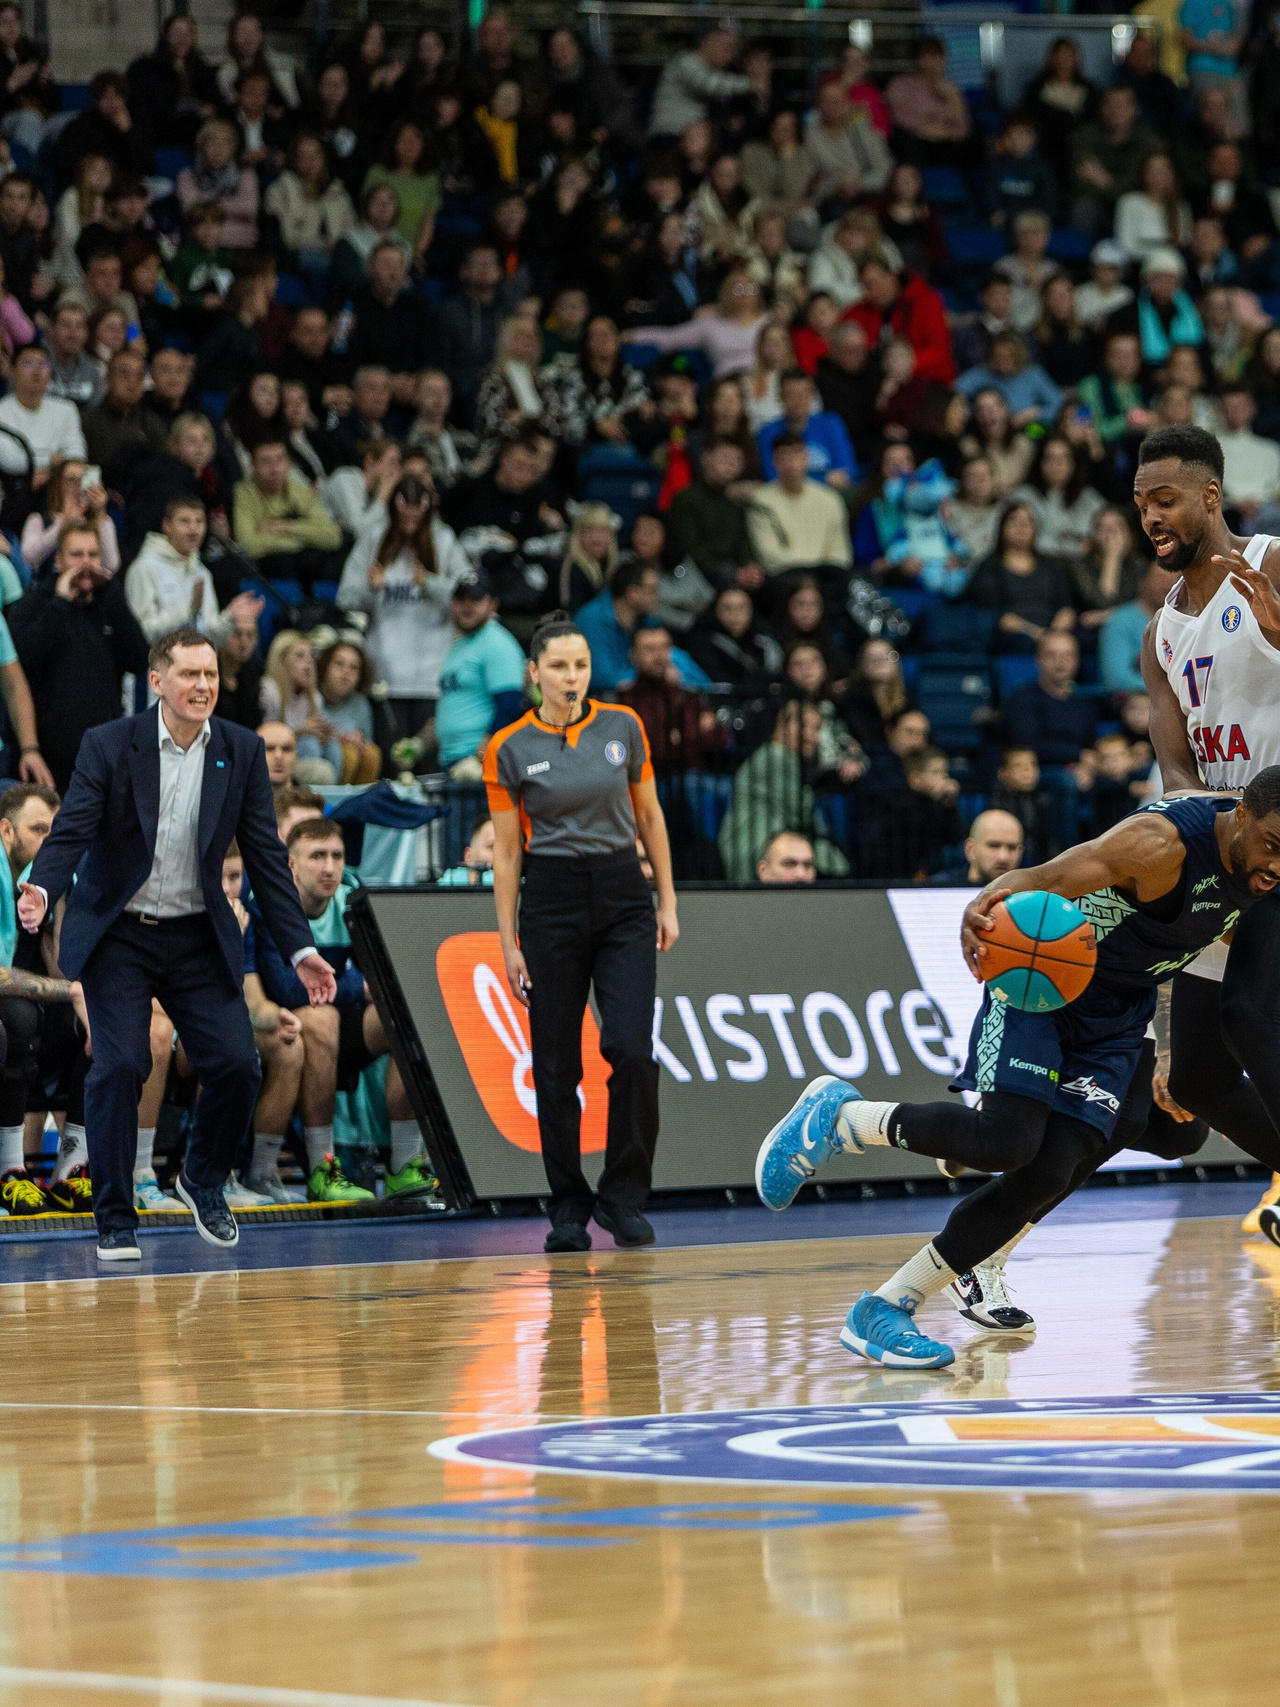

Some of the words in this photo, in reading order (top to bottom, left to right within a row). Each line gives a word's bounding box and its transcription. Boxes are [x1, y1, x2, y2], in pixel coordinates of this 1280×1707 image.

[1182, 655, 1214, 708] 17
[1187, 724, 1251, 763] SKA
[1009, 1057, 1048, 1076] Kempa
